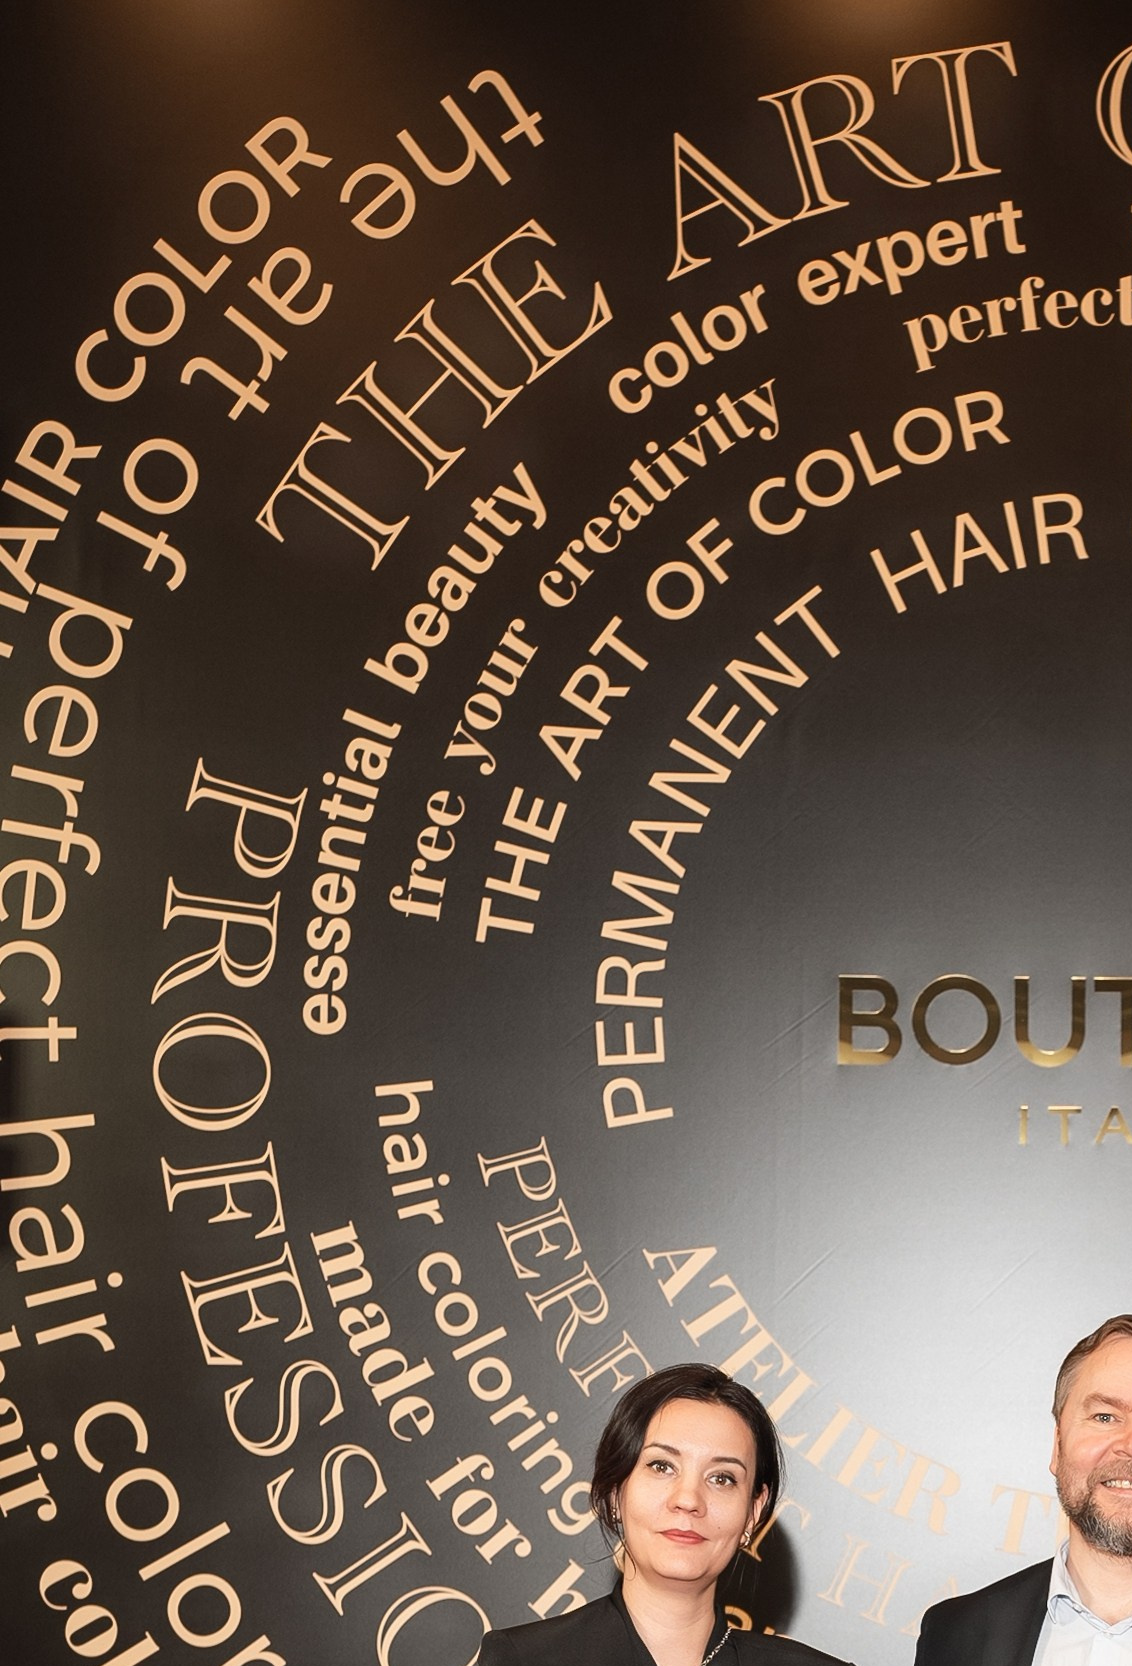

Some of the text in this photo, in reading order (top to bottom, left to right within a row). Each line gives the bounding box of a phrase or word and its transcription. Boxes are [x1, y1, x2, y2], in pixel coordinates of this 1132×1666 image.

[179, 246, 334, 421] art
[254, 218, 614, 572] THE
[666, 40, 1018, 282] ART
[339, 69, 545, 240] the
[608, 200, 1027, 414] color expert
[0, 116, 333, 659] AIR COLOR
[95, 437, 199, 592] of
[0, 582, 134, 1063] perfect
[302, 461, 548, 1036] essential beauty
[388, 377, 781, 922] free your creativity
[475, 390, 1012, 944] THE ART OF COLOR
[595, 584, 841, 1129] PERMANENT
[869, 492, 1090, 614] HAIR
[0, 1113, 124, 1353] hair
[309, 1220, 532, 1565] made for
[374, 1079, 450, 1225] hair
[417, 1251, 596, 1536] coloring
[476, 1135, 811, 1562] PERFT
[642, 1243, 962, 1536] ATELIER
